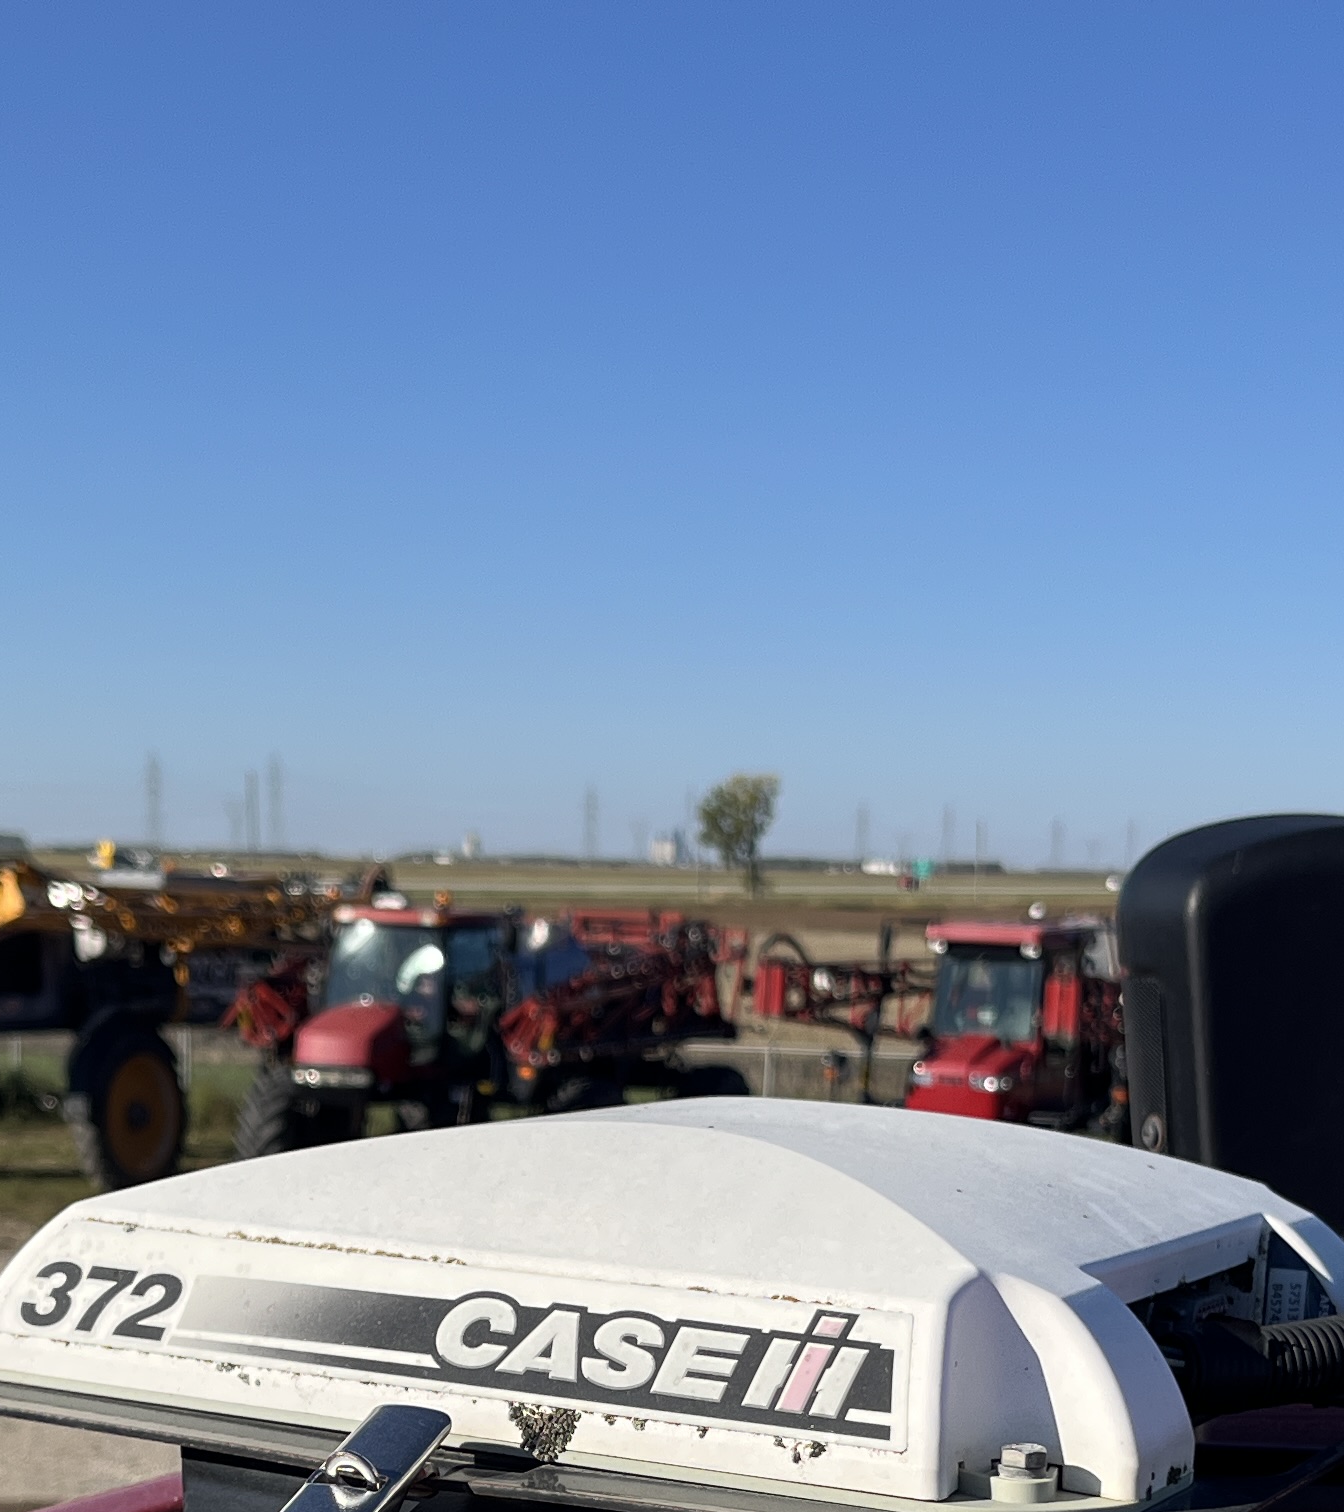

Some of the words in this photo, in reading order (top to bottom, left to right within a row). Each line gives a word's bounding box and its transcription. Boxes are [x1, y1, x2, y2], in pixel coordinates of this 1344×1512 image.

[20, 1261, 183, 1342] 372
[1269, 1283, 1283, 1325] B4574
[435, 1296, 749, 1402] CASE
